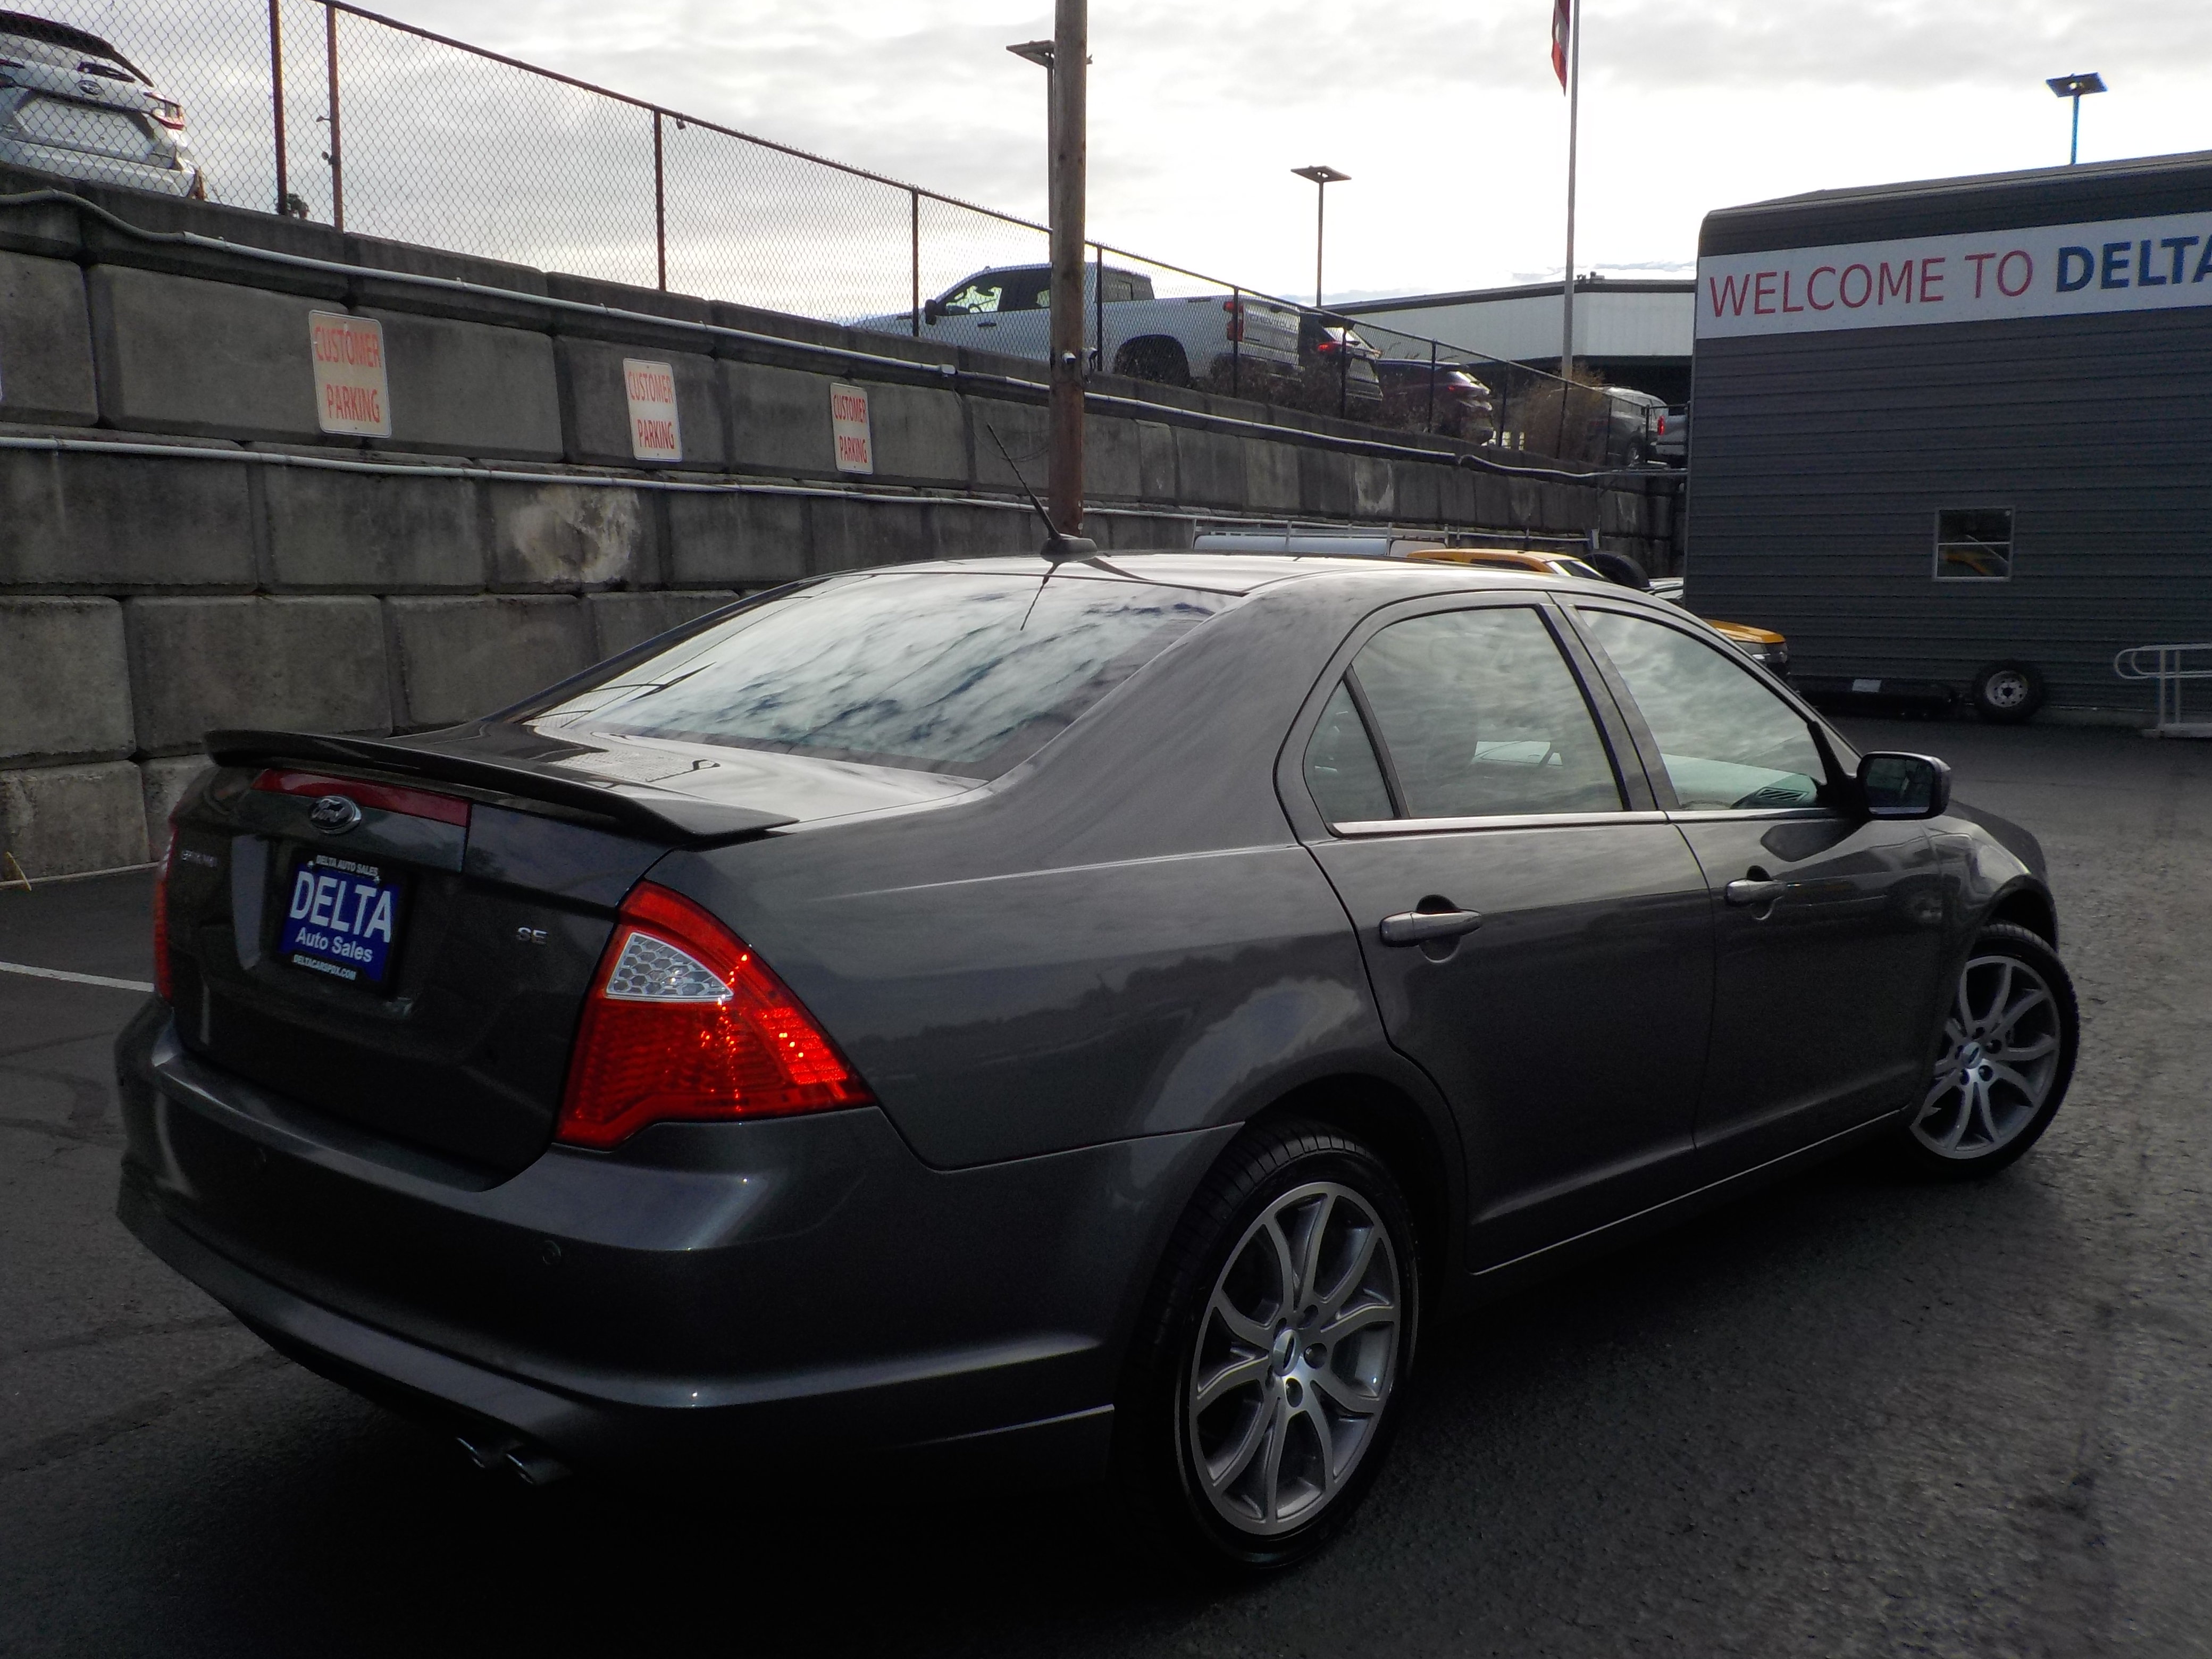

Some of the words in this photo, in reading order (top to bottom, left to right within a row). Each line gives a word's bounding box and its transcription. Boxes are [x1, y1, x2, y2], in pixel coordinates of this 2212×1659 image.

[1709, 257, 1946, 319] WELCOME
[1964, 249, 2034, 299] TO
[315, 326, 381, 368] CUSTOMER
[325, 383, 380, 424] PARKING
[628, 371, 674, 404] CUSTOMER
[833, 394, 867, 424] CUSTOMER
[637, 418, 675, 450] PARKING
[839, 434, 867, 464] PARKING
[315, 854, 337, 868] DELTA
[338, 859, 356, 873] AUTO
[356, 862, 379, 877] SALES
[289, 870, 392, 943] DELTA
[295, 927, 329, 951] Auto
[331, 935, 373, 963] Sales
[516, 926, 548, 945] SE
[292, 954, 357, 981] DELTACARSPDX.COM
